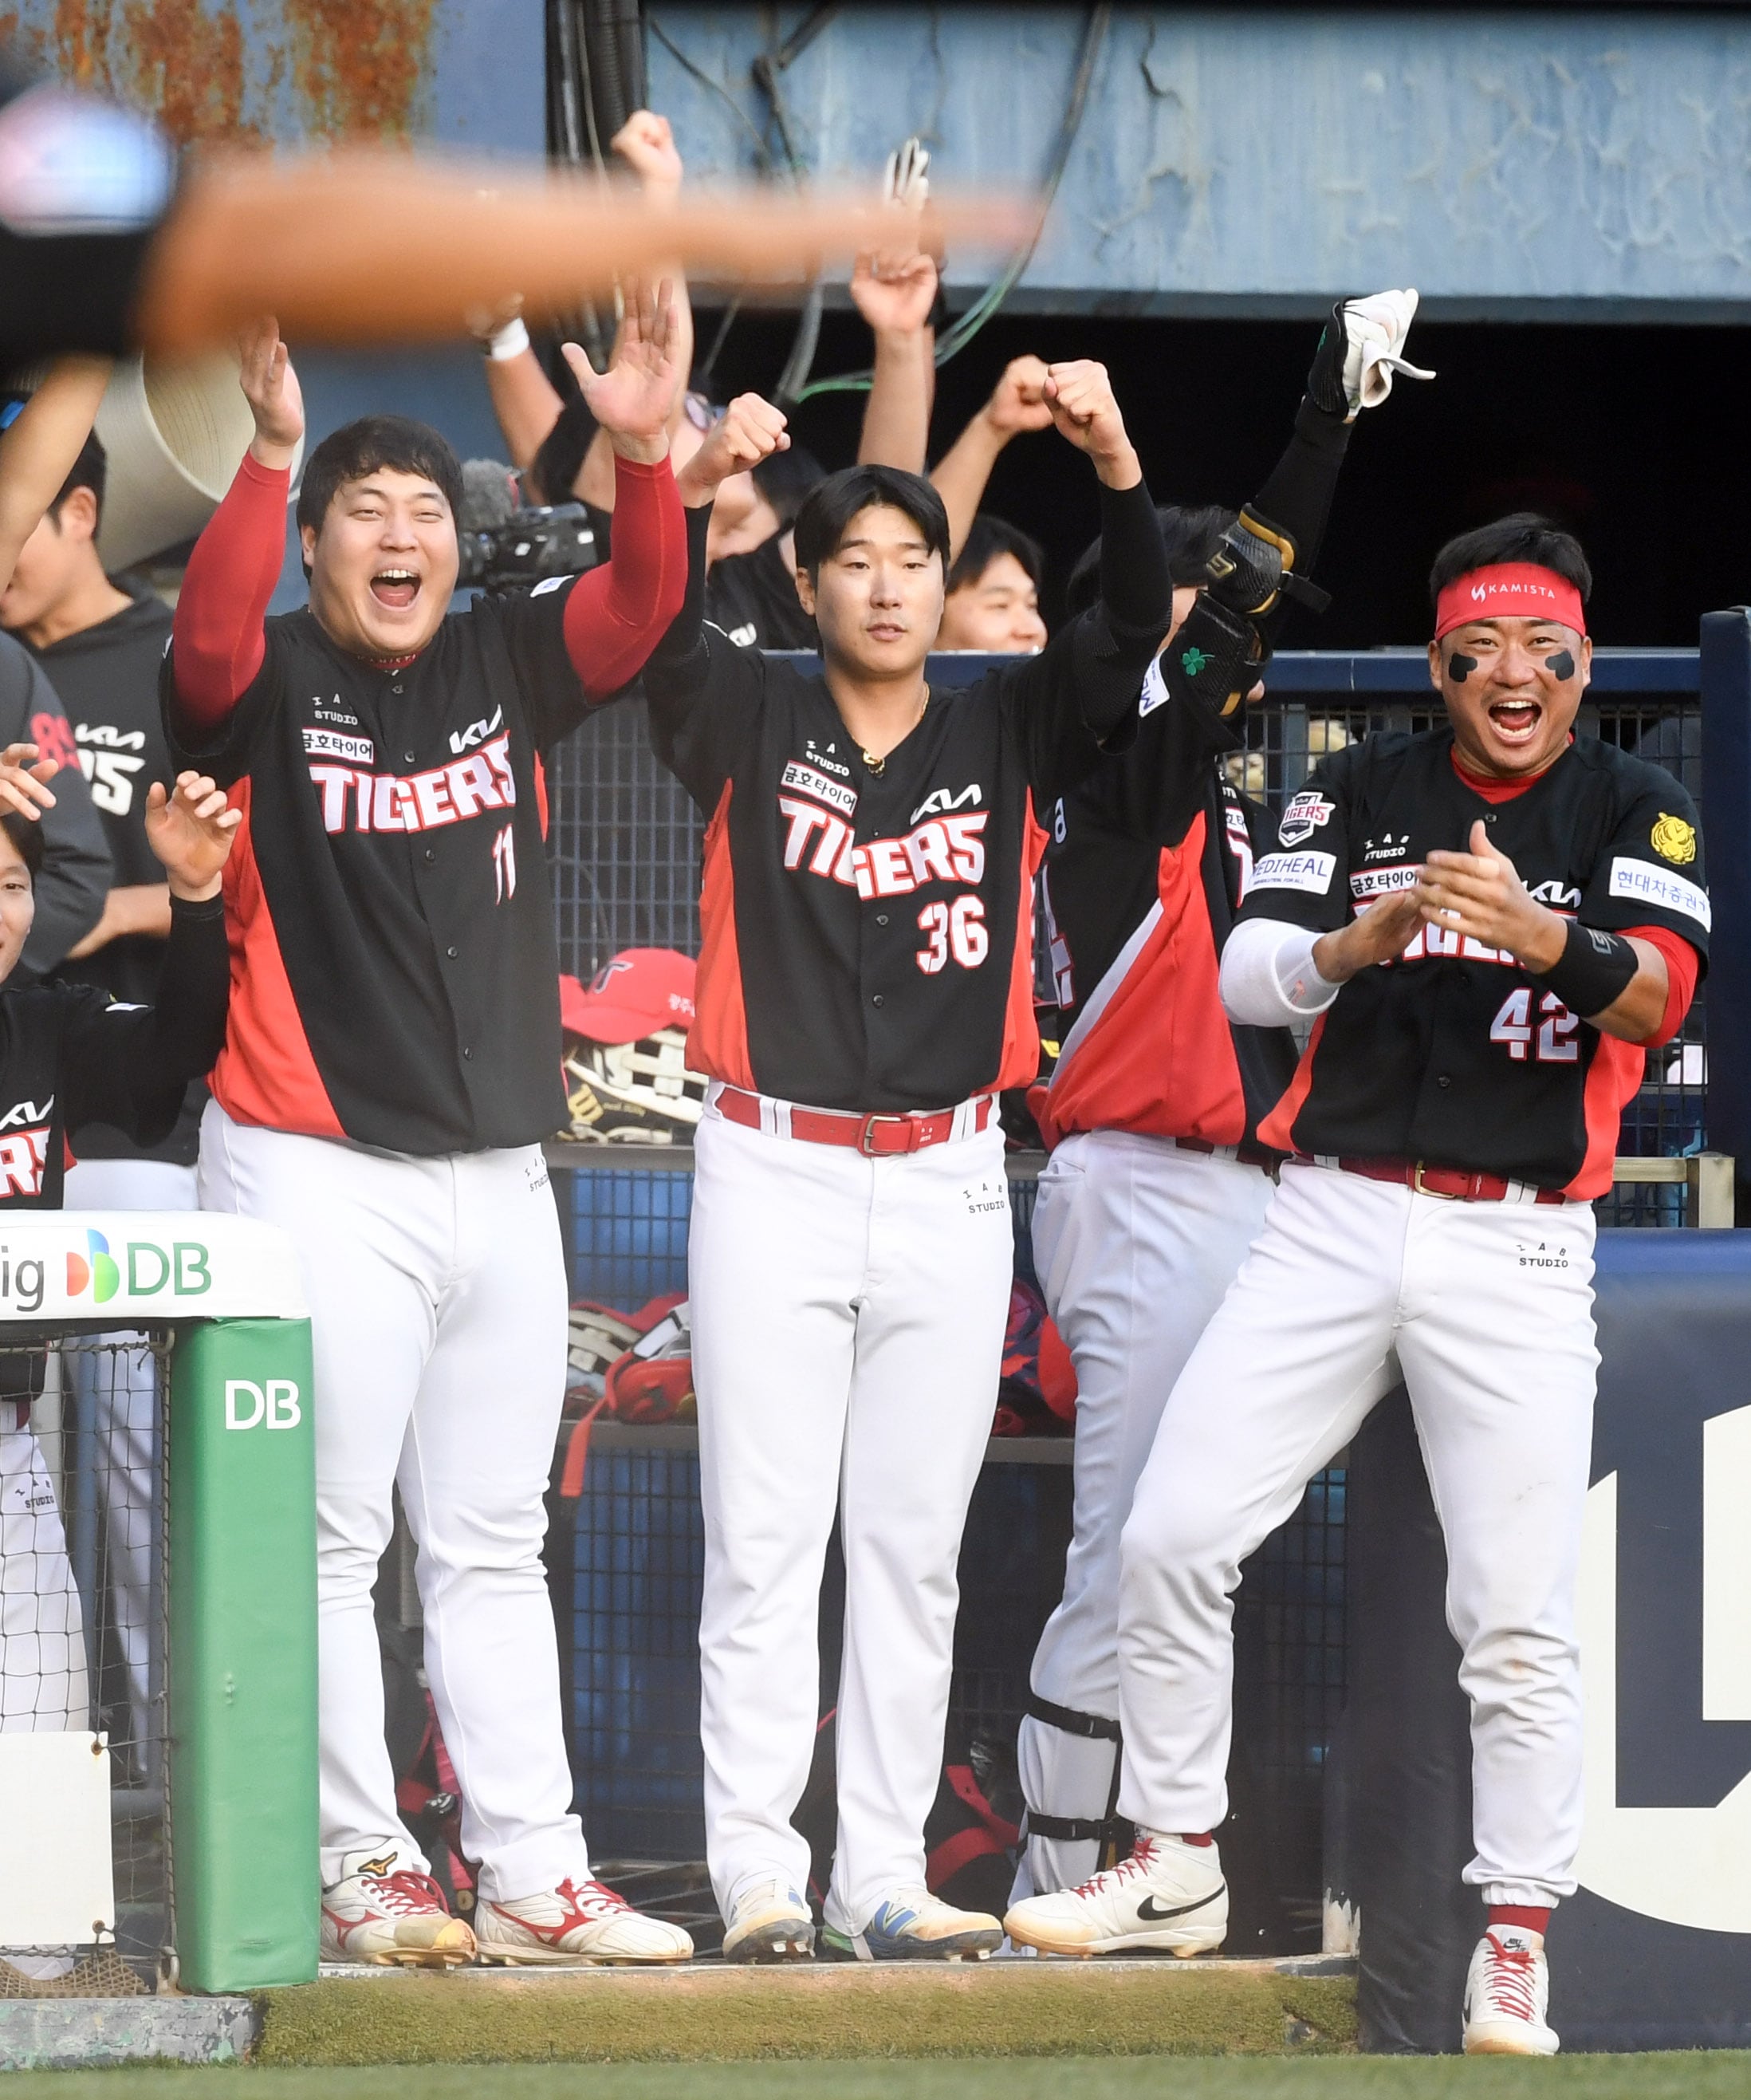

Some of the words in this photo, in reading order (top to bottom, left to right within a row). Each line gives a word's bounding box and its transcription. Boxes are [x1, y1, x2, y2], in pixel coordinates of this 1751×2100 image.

[1489, 583, 1556, 599] KAMISTA
[314, 710, 358, 726] STUDIO
[302, 731, 374, 759] 금호타이어
[805, 751, 851, 777] STUDIO
[309, 729, 517, 834] TIGERS
[785, 766, 856, 812] 금호타이어
[1285, 805, 1329, 821] IGERS
[492, 823, 517, 906] 11
[777, 794, 990, 901] TIGERS
[1364, 846, 1407, 861] STUDIO
[1253, 857, 1328, 877] EDIHEAL
[1617, 870, 1698, 911] 현대차증권
[916, 893, 990, 975] 36
[1489, 987, 1580, 1063] 42
[968, 1200, 1005, 1214] STUDIO
[127, 1242, 212, 1296] DB
[1519, 1257, 1568, 1268] STUDIO
[225, 1379, 301, 1430] DB
